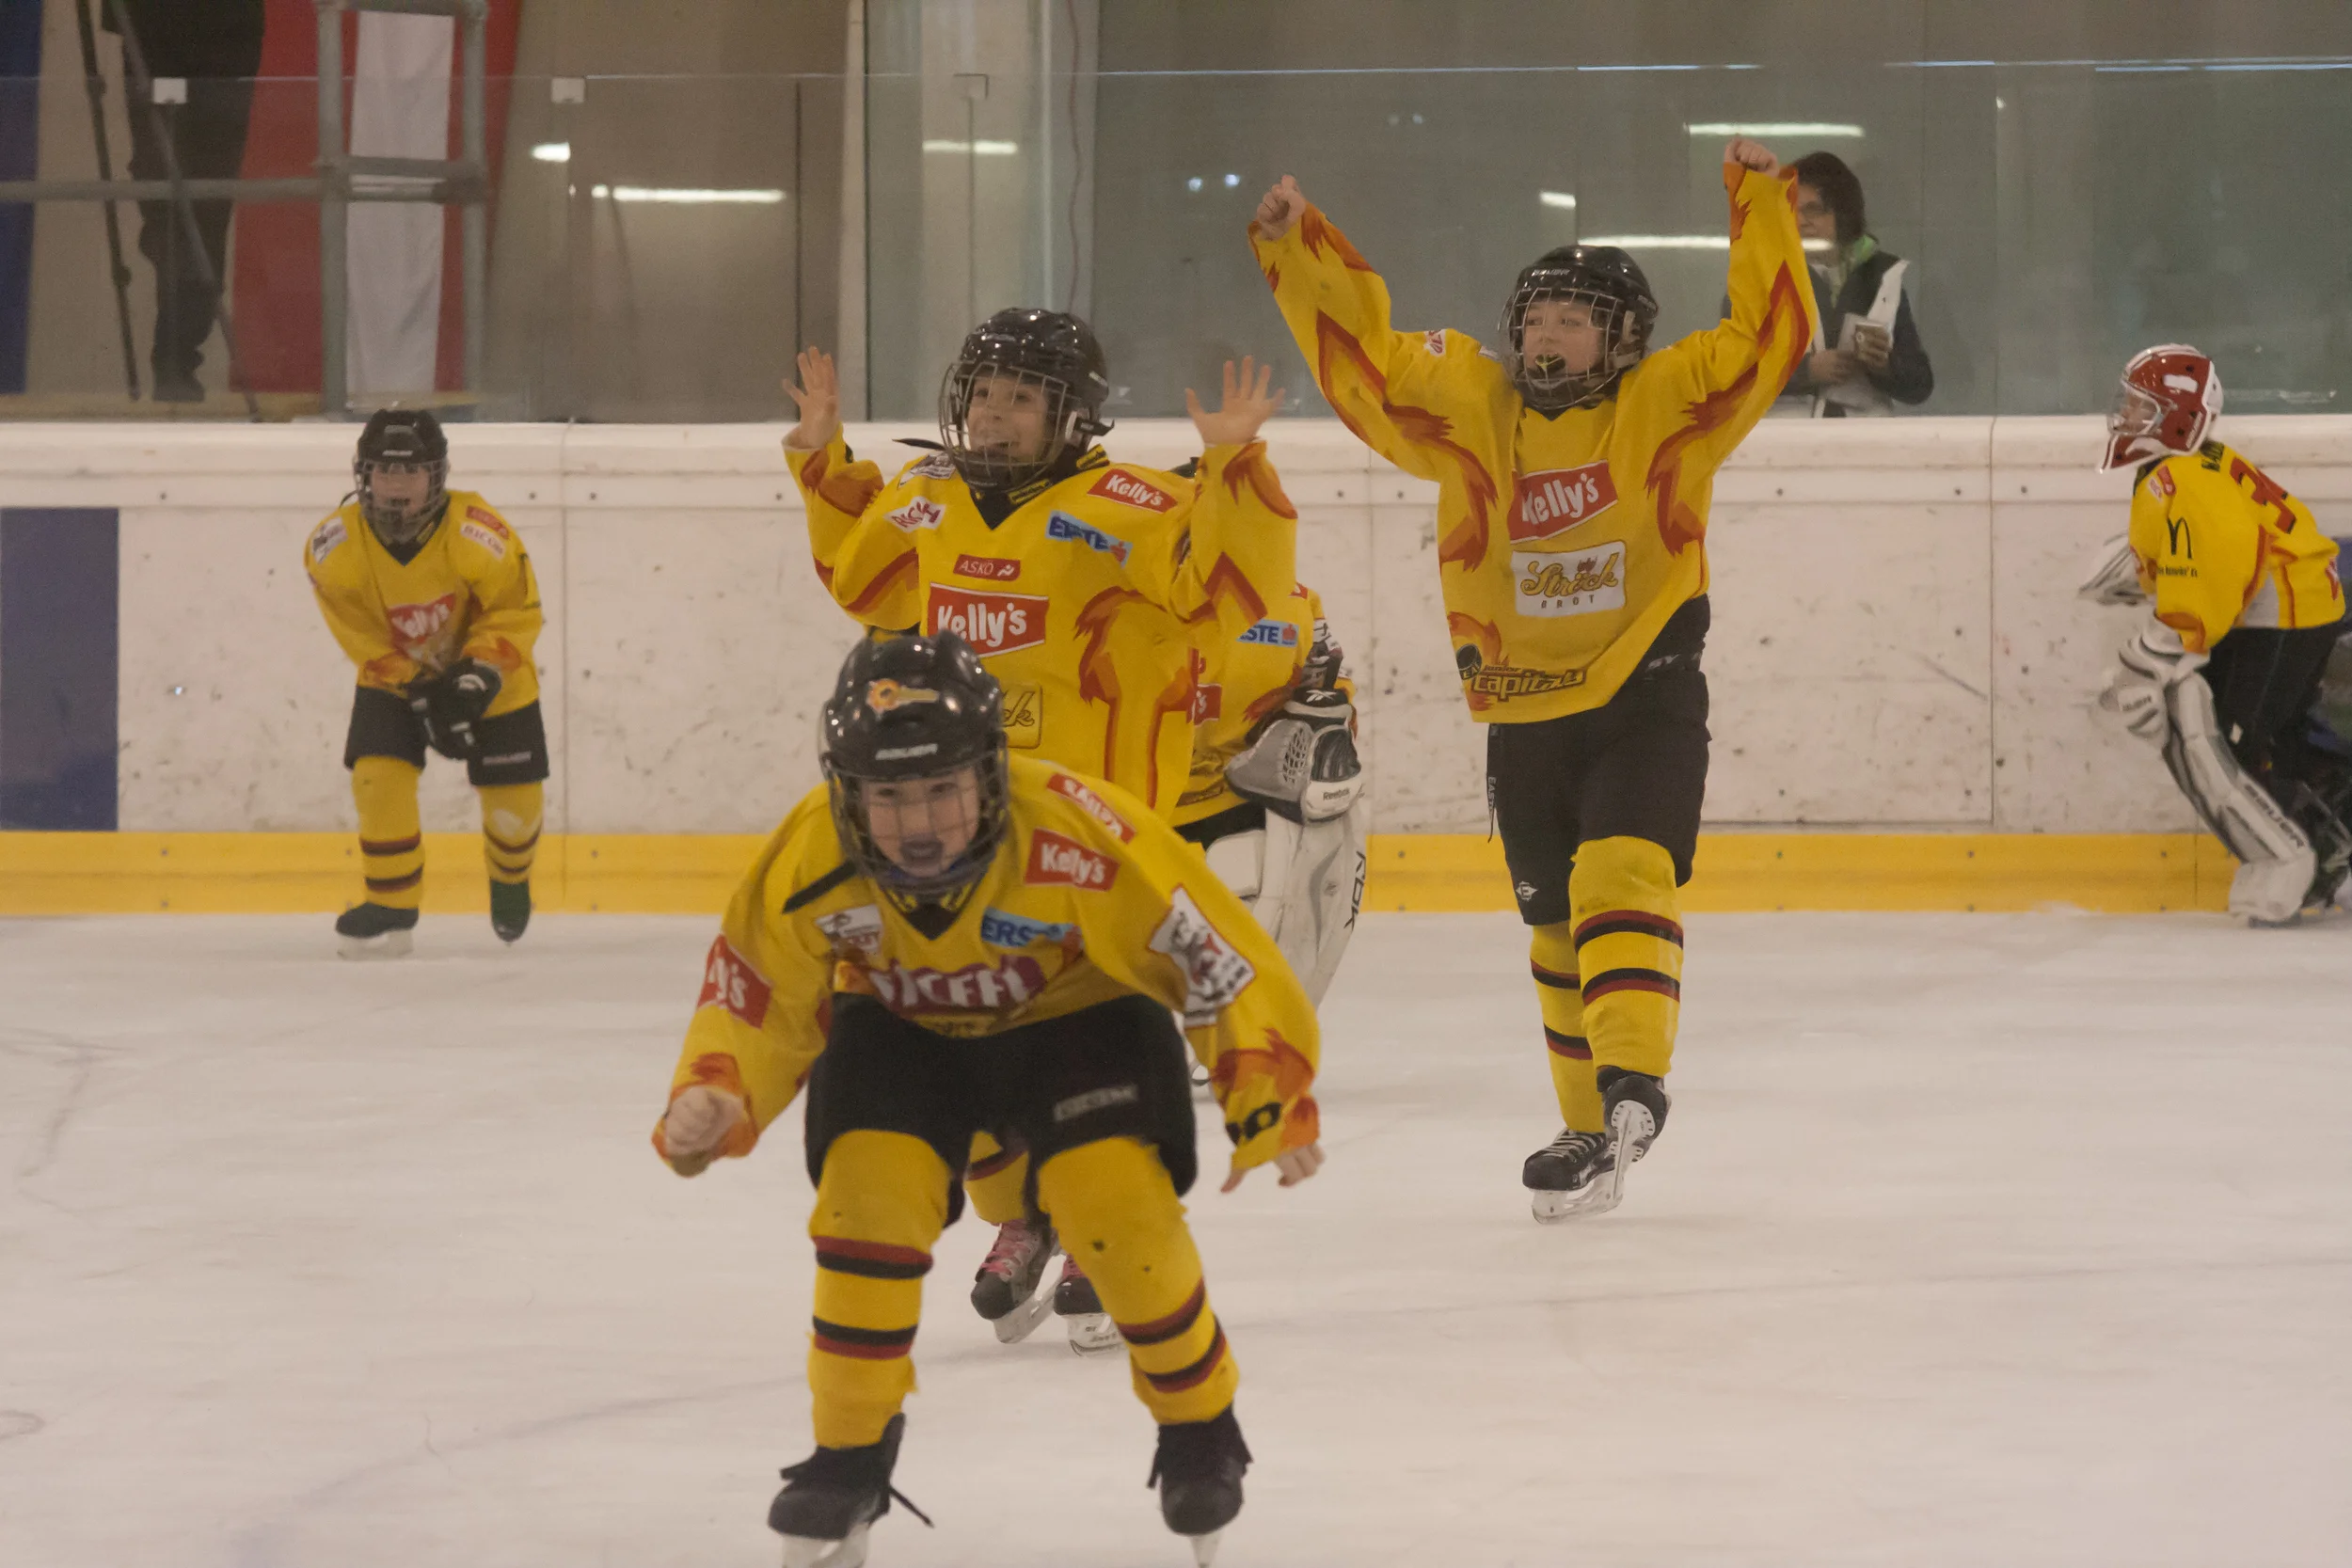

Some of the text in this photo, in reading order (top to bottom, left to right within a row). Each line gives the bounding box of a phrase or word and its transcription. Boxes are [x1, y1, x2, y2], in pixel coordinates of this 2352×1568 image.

[1104, 474, 1164, 507] Kelly's
[1520, 471, 1599, 526] Kelly's
[959, 559, 994, 577] ASKÖ
[1540, 594, 1595, 610] BROT
[936, 602, 1028, 647] Kelly's
[1239, 624, 1280, 644] STE
[1041, 841, 1106, 884] Kelly's
